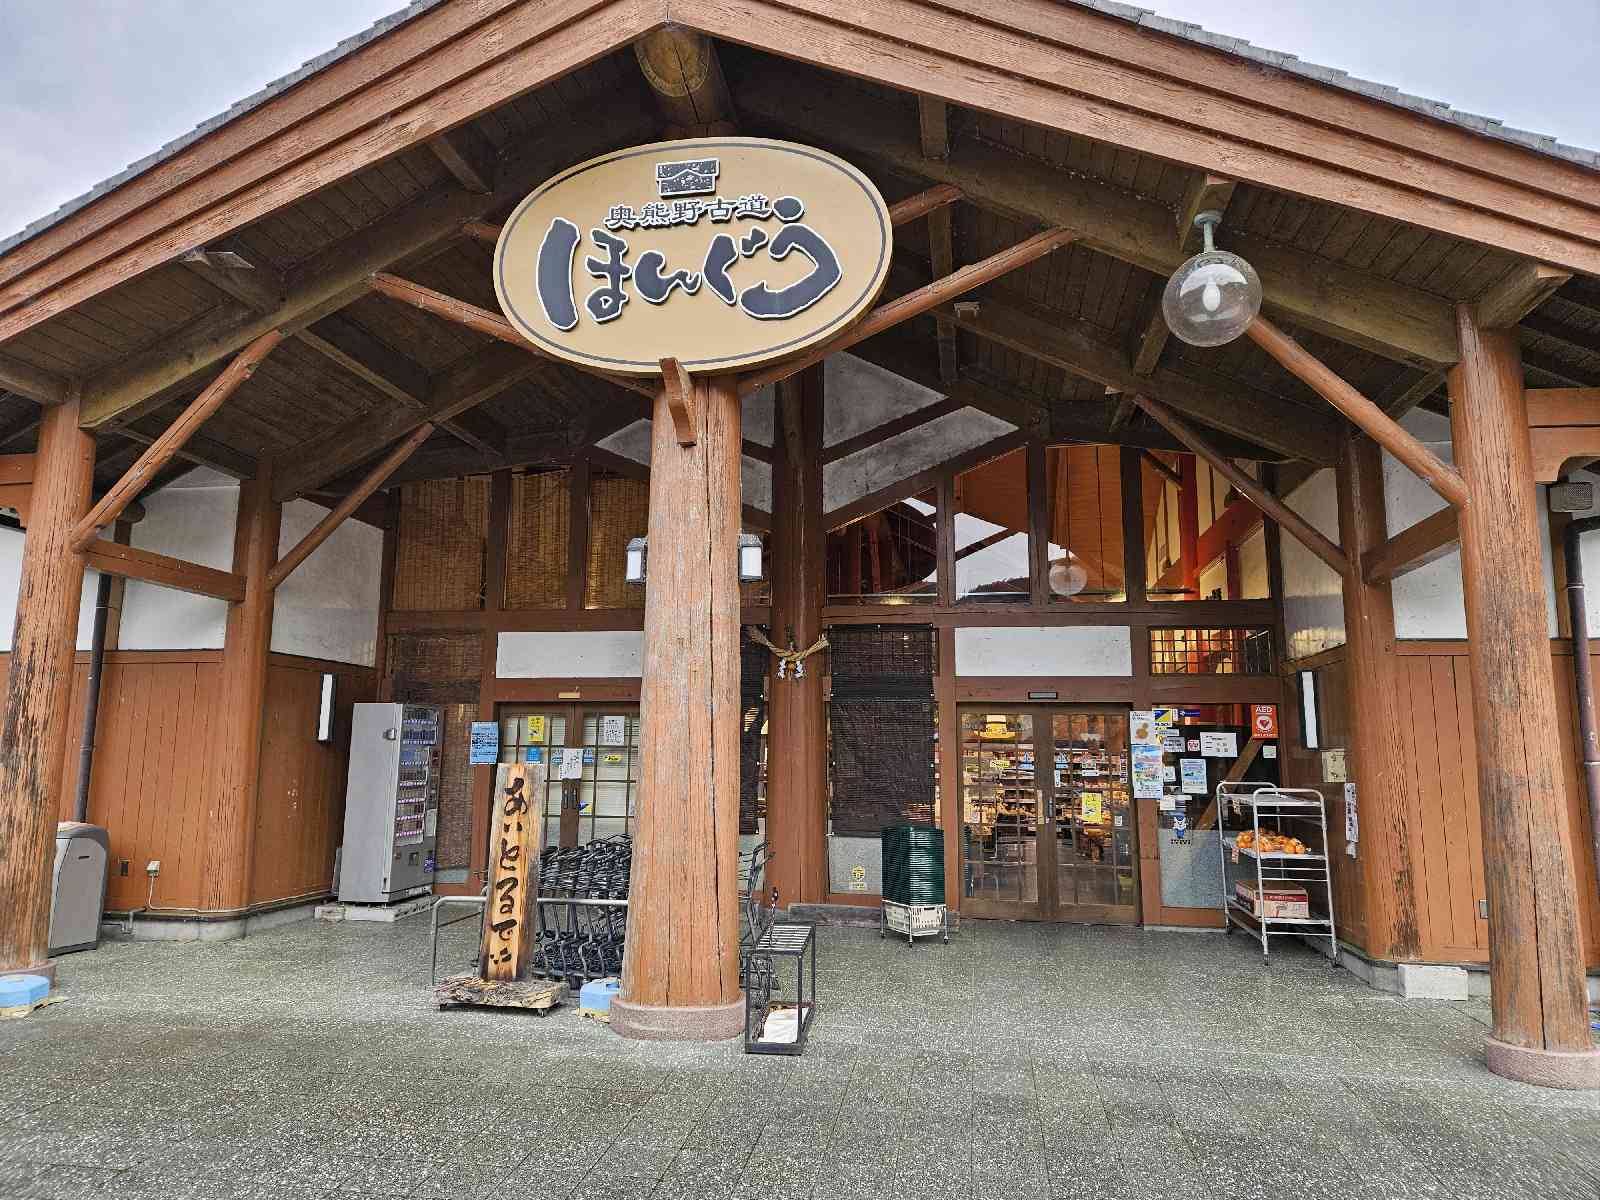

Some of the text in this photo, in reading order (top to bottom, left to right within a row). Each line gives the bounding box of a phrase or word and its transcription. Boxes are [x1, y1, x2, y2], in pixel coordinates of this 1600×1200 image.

[606, 195, 772, 230] 奥熊野古道
[537, 197, 842, 329] ほんぐう
[1255, 704, 1273, 713] AED
